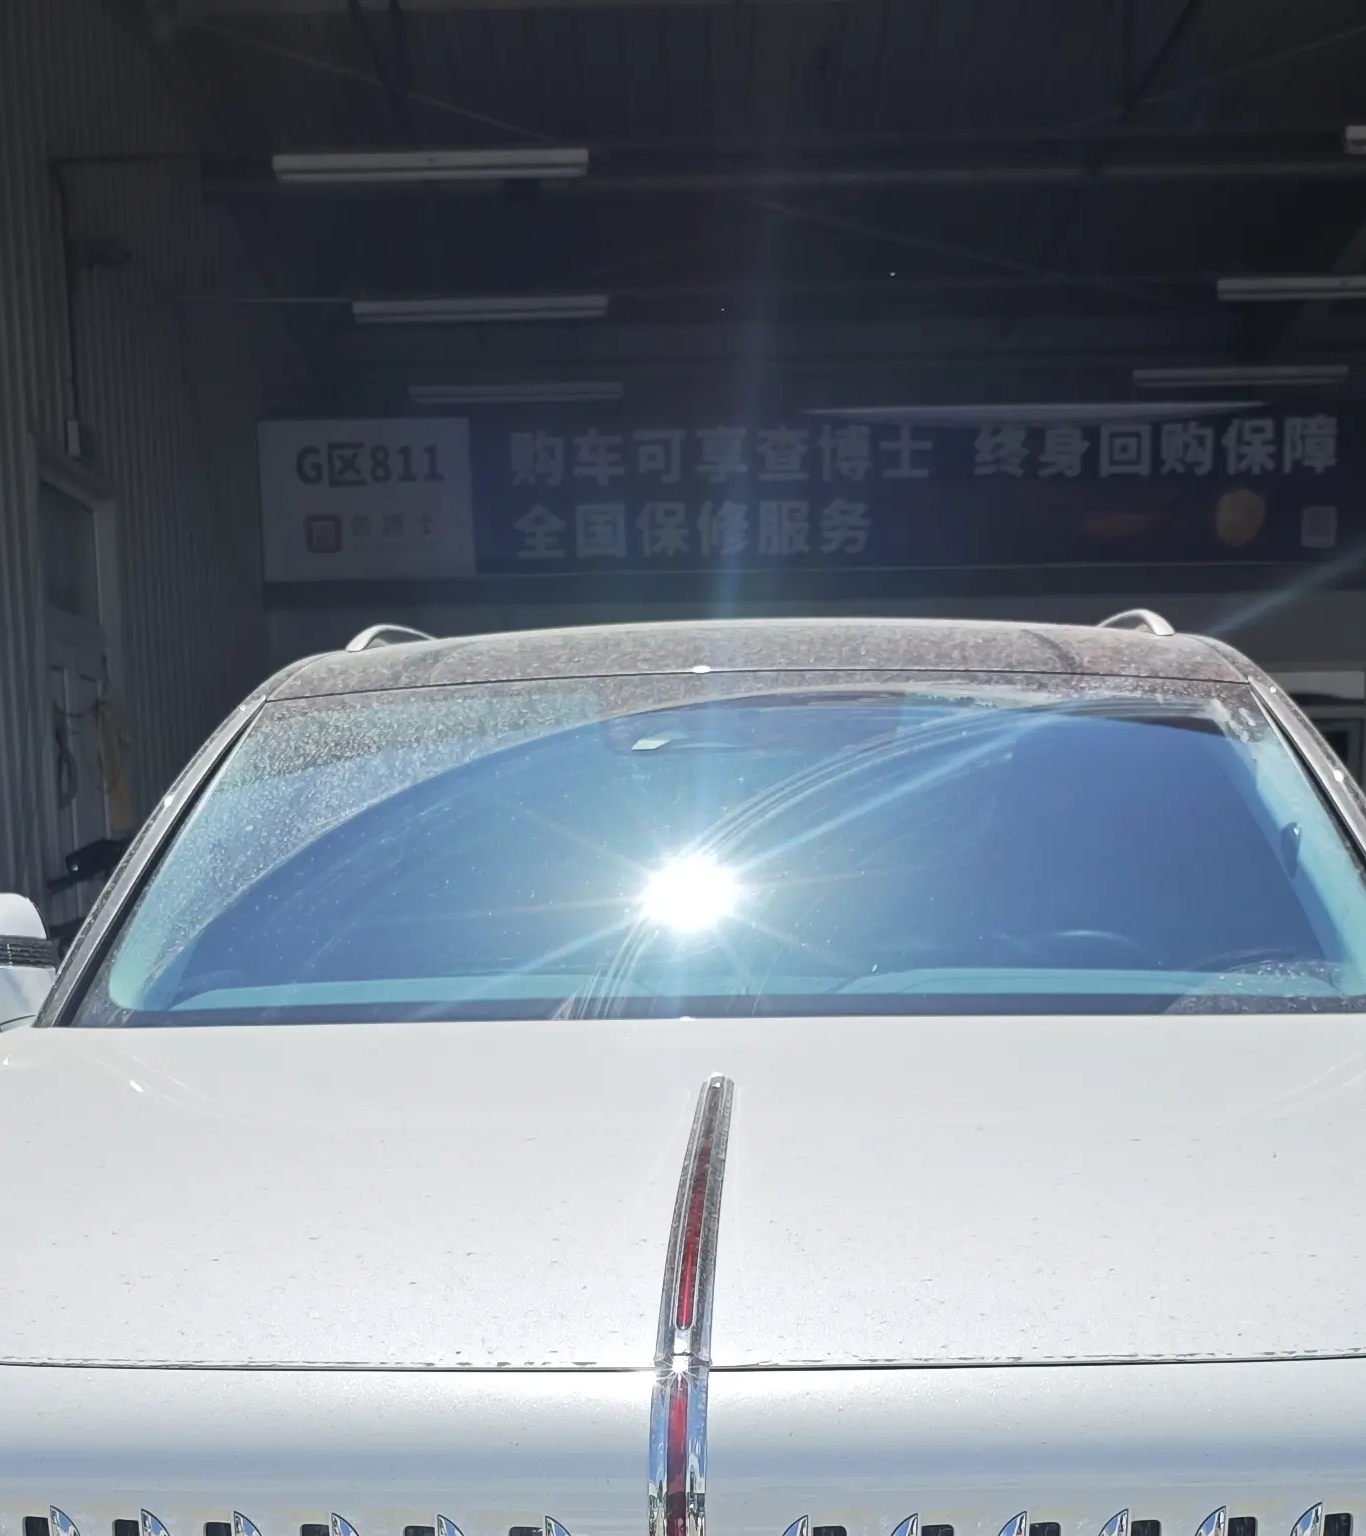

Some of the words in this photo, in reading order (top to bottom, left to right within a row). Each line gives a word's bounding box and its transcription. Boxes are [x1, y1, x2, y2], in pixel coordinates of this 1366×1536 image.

[297, 442, 444, 487] G区811
[510, 424, 933, 485] 购车可享查博士
[972, 414, 1339, 478] 终身回购保障
[514, 496, 872, 559] 全国保修服务
